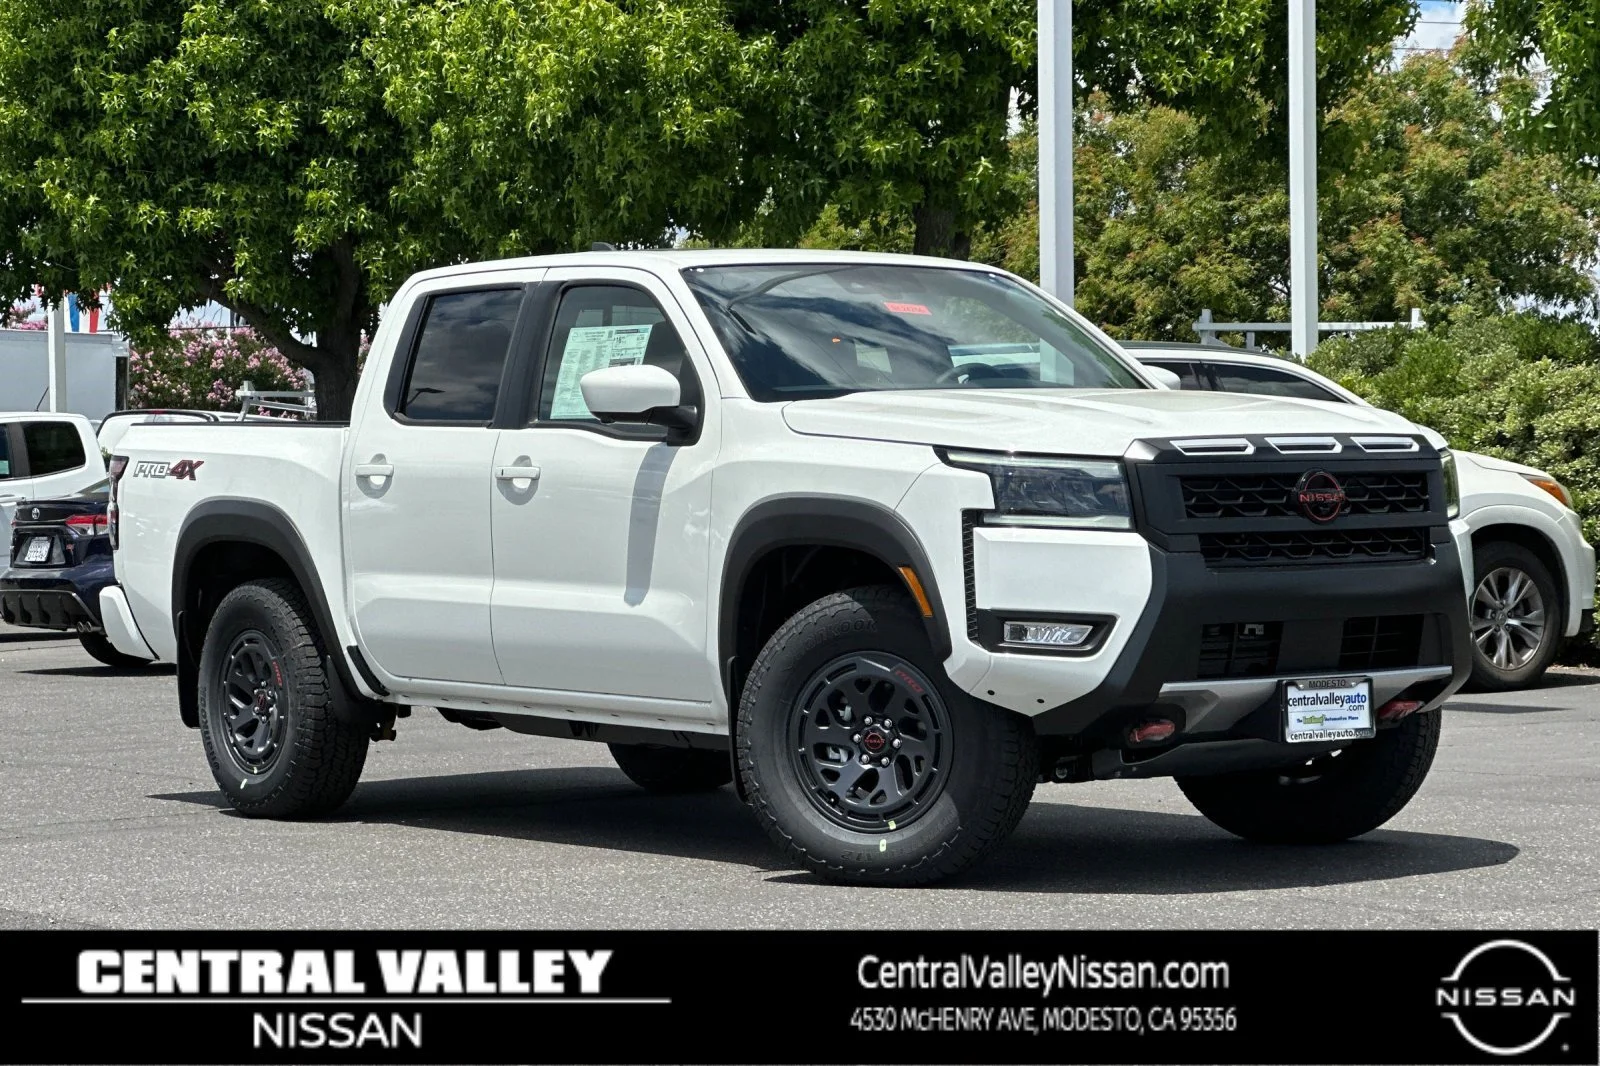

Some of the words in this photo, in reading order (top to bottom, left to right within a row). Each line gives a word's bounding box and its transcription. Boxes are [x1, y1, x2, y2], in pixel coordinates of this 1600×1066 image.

[1308, 680, 1346, 688] MODESTO
[1288, 692, 1367, 707] centralvalleyauto
[1290, 729, 1371, 741] centralvalleyauto.com
